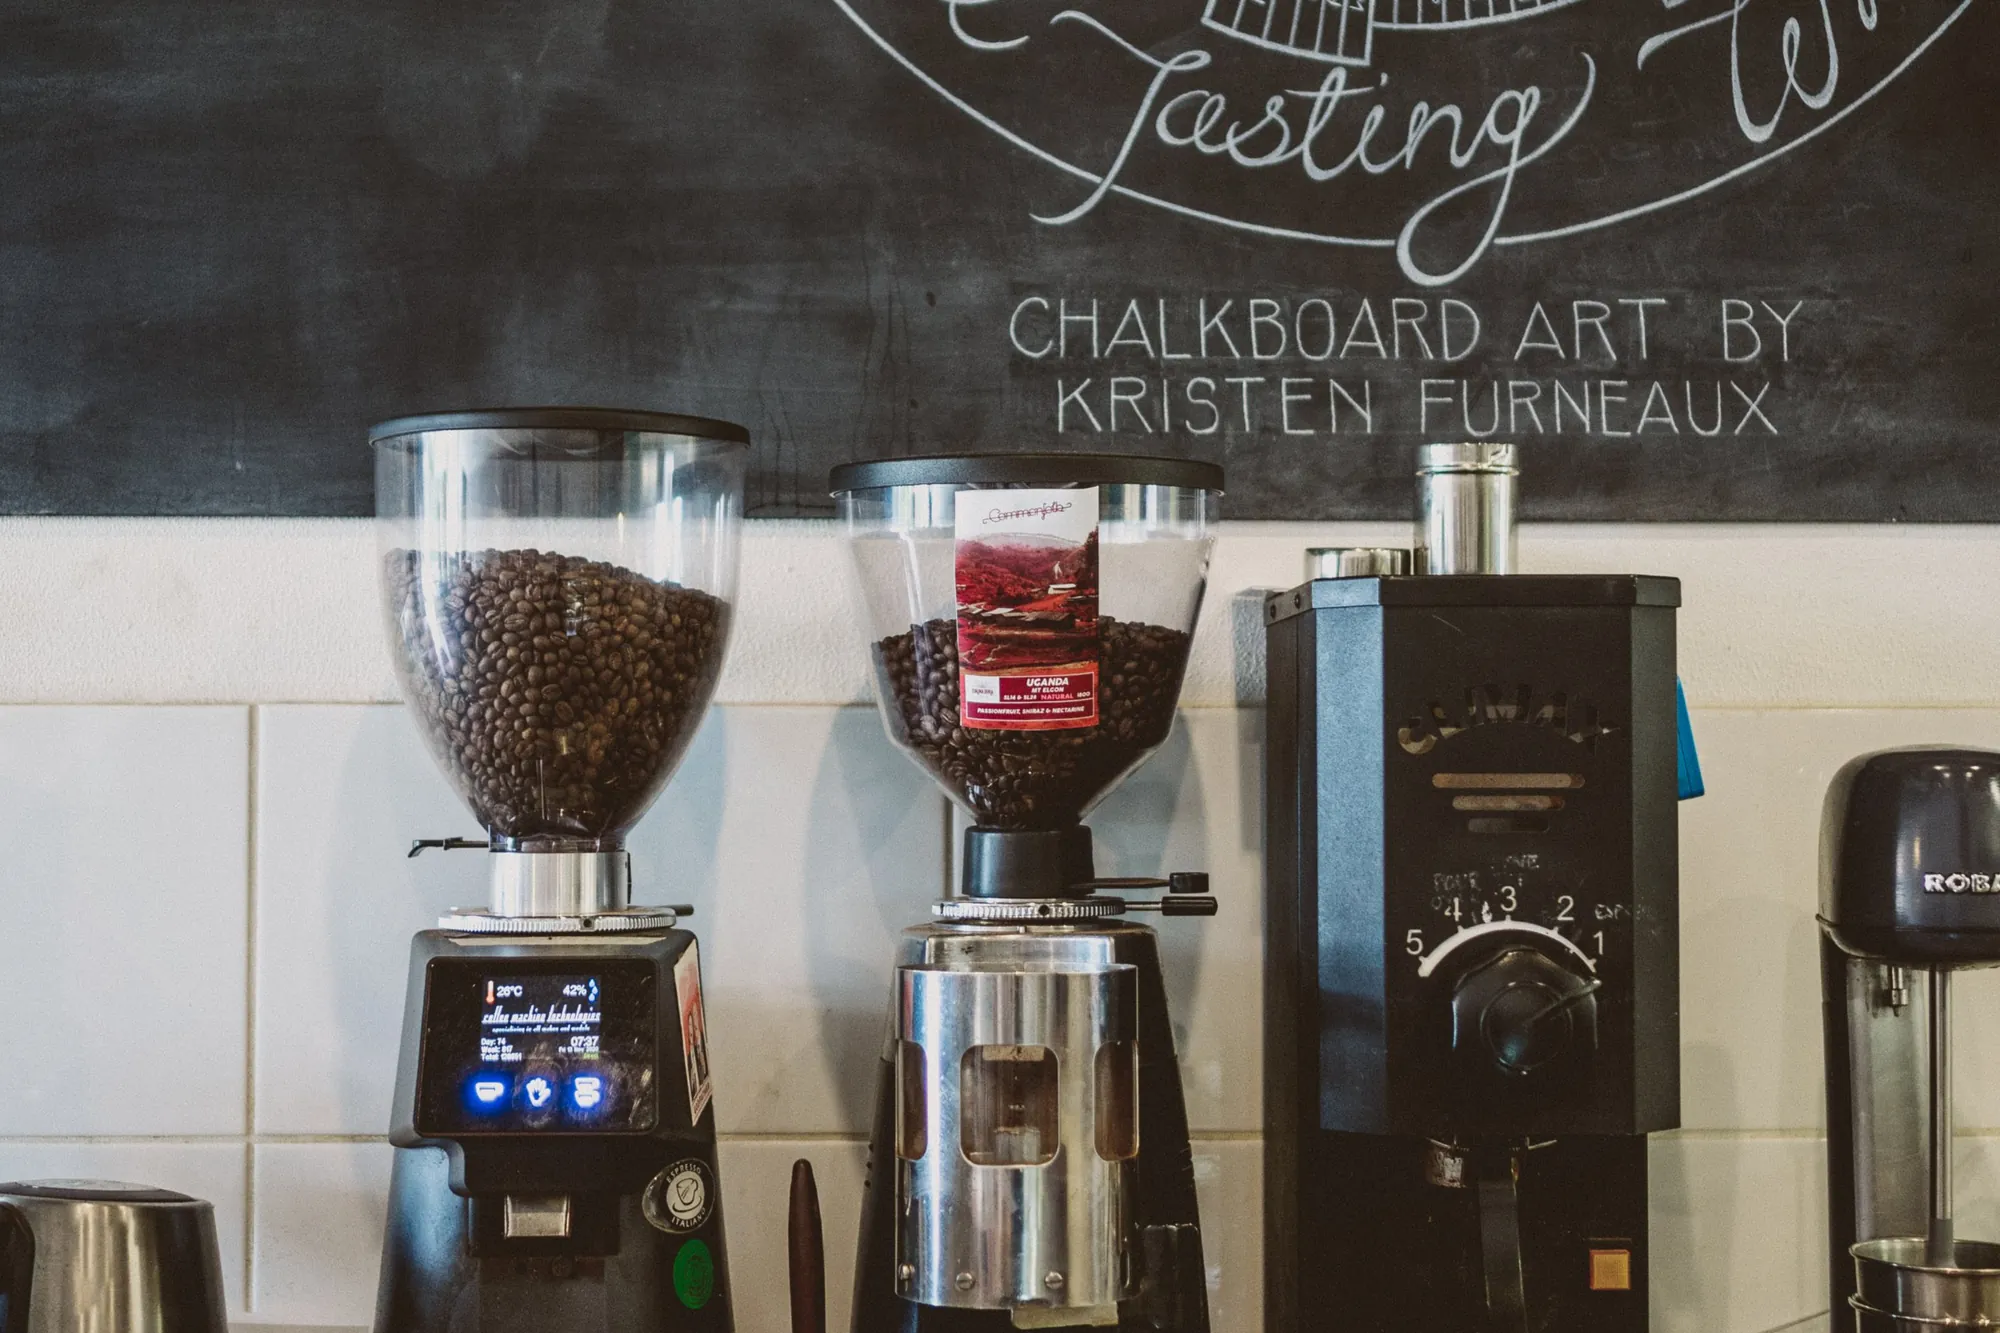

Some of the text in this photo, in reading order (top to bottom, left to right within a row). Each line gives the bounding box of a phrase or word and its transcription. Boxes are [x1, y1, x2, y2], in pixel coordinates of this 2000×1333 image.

[1030, 10, 1595, 286] Tasting
[1009, 296, 1803, 363] CHALKBOARD ART BY
[1057, 376, 1779, 437] KRISTEN FURNEAUX
[1026, 677, 1069, 687] UGANDA
[1406, 929, 1424, 955] 5
[1444, 897, 1463, 922] 4
[1500, 885, 1517, 912] 3
[1556, 895, 1574, 921] 2
[1592, 931, 1604, 955] 1
[562, 984, 587, 997] 42%
[546, 1004, 601, 1024] technologies
[666, 1163, 702, 1184] ESPRESSO
[671, 1207, 706, 1228] ITALIANO
